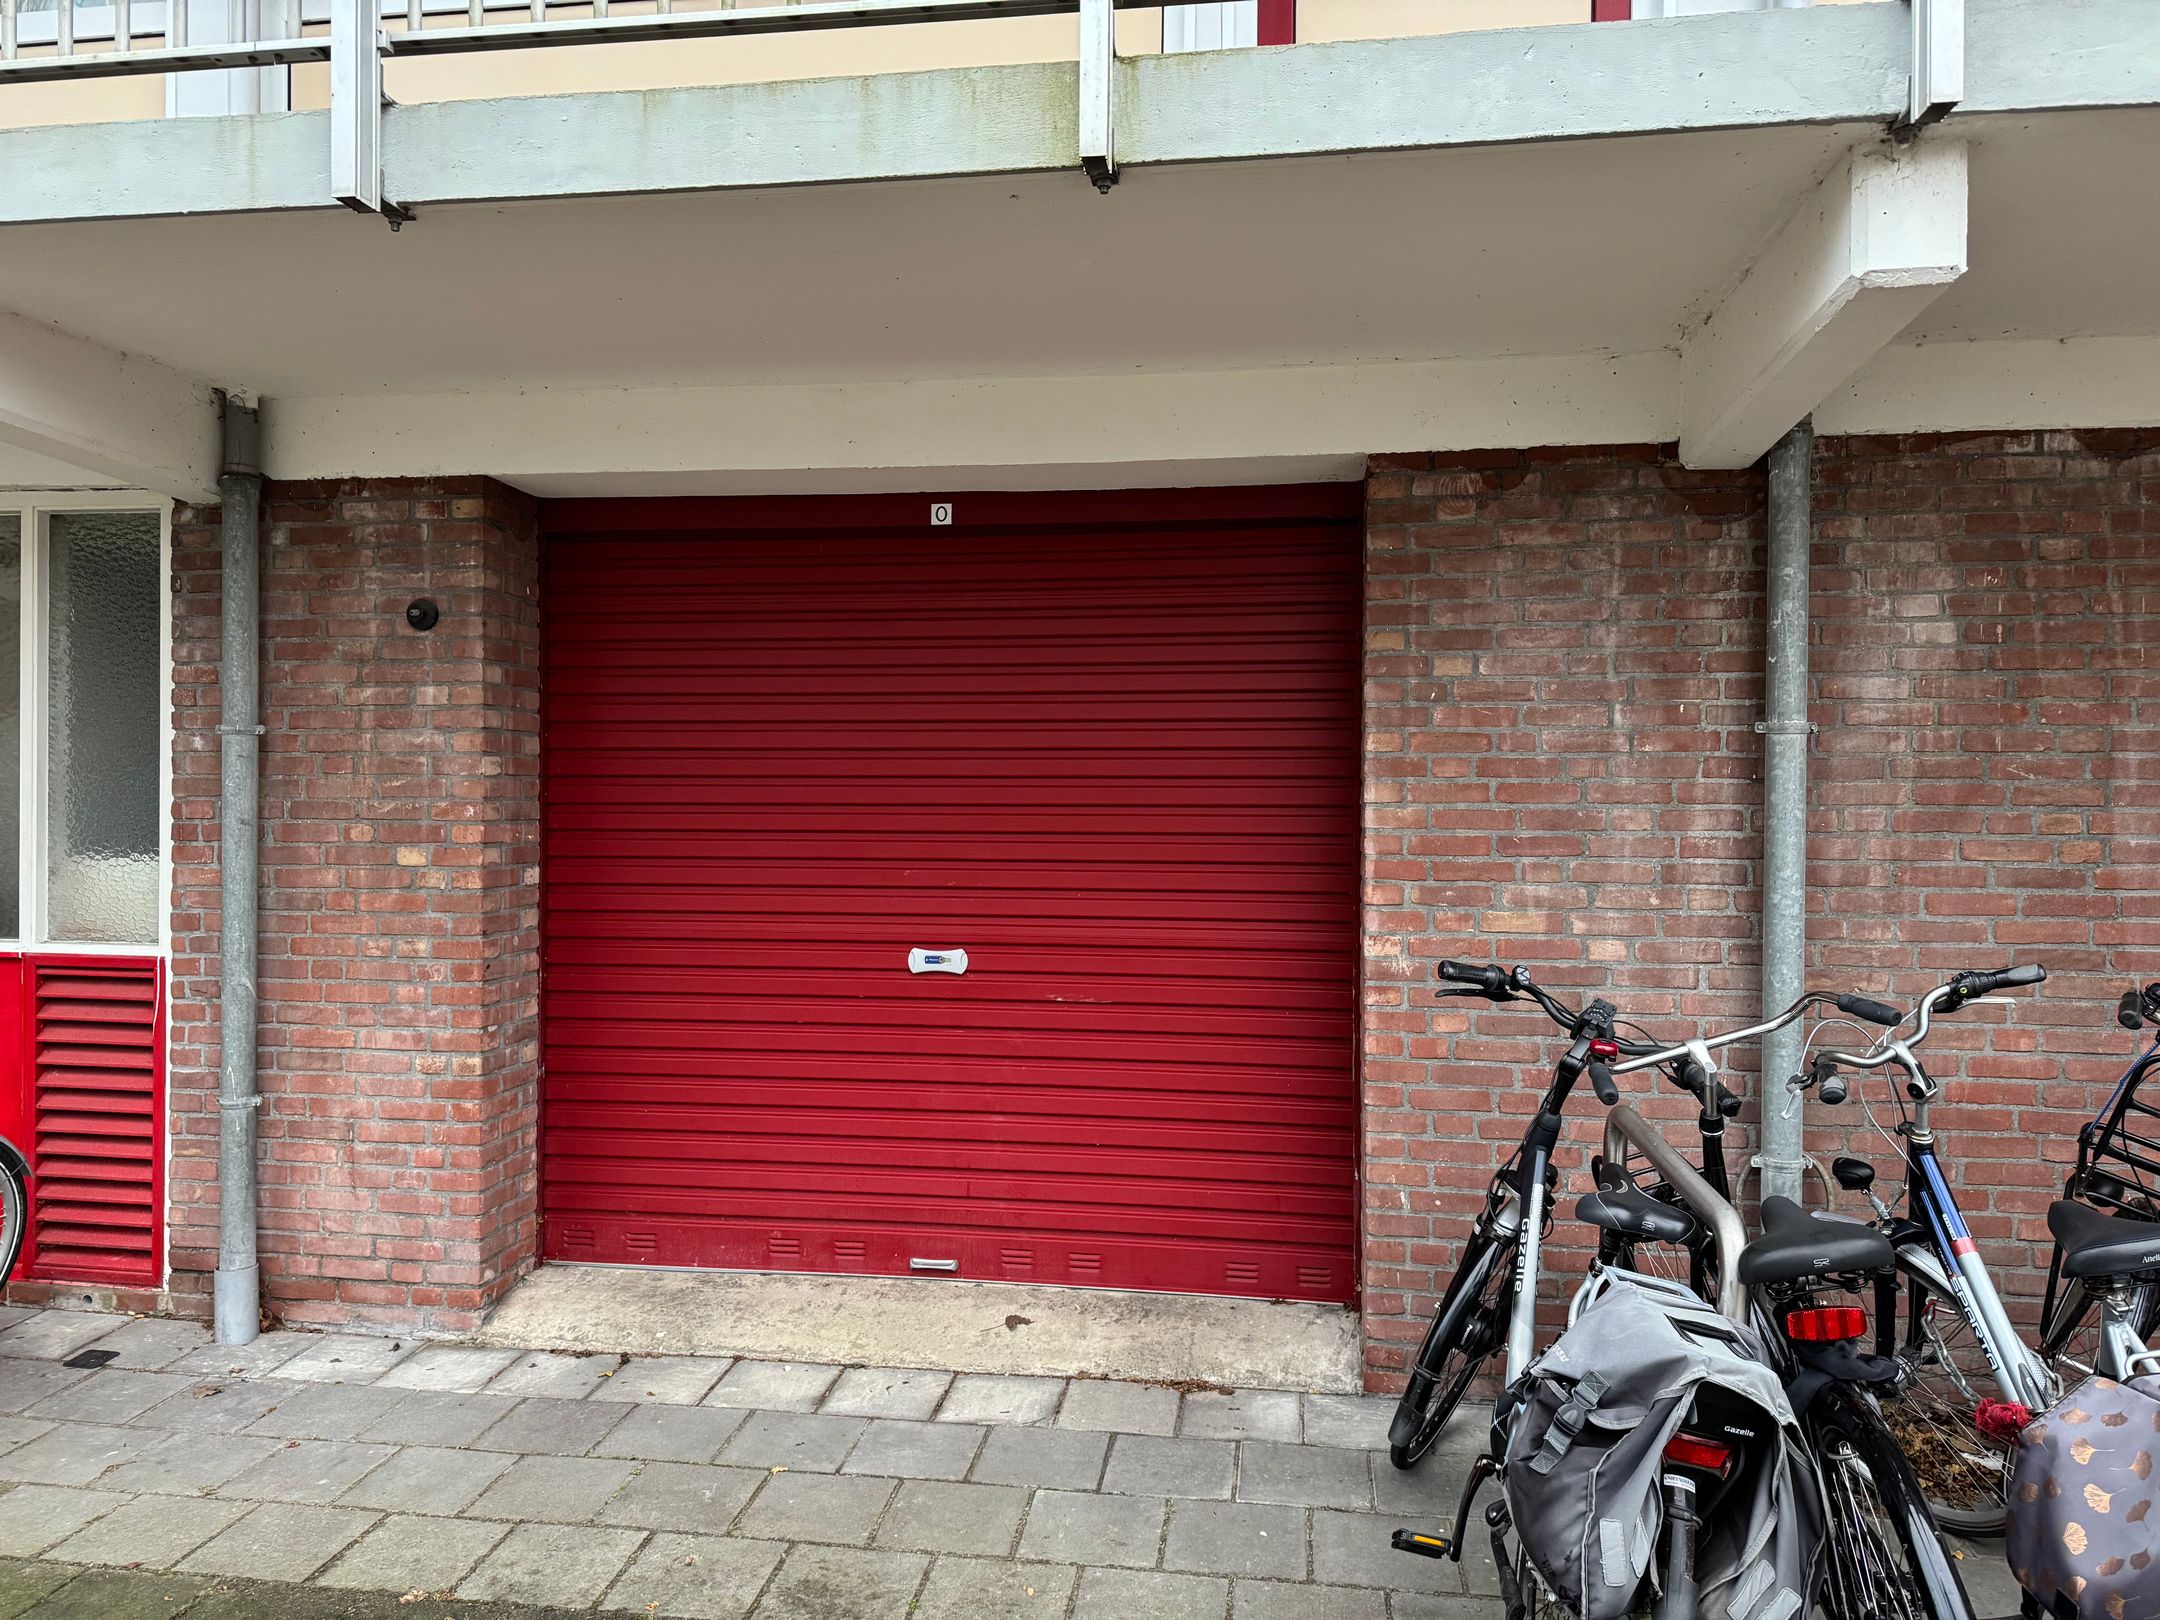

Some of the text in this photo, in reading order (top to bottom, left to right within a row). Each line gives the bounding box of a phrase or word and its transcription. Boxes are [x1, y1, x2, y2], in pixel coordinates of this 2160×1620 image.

[1514, 1217, 1530, 1293] Gazelle
[1950, 1276, 1999, 1371] SPARTA
[1724, 1425, 1755, 1438] Gazelle
